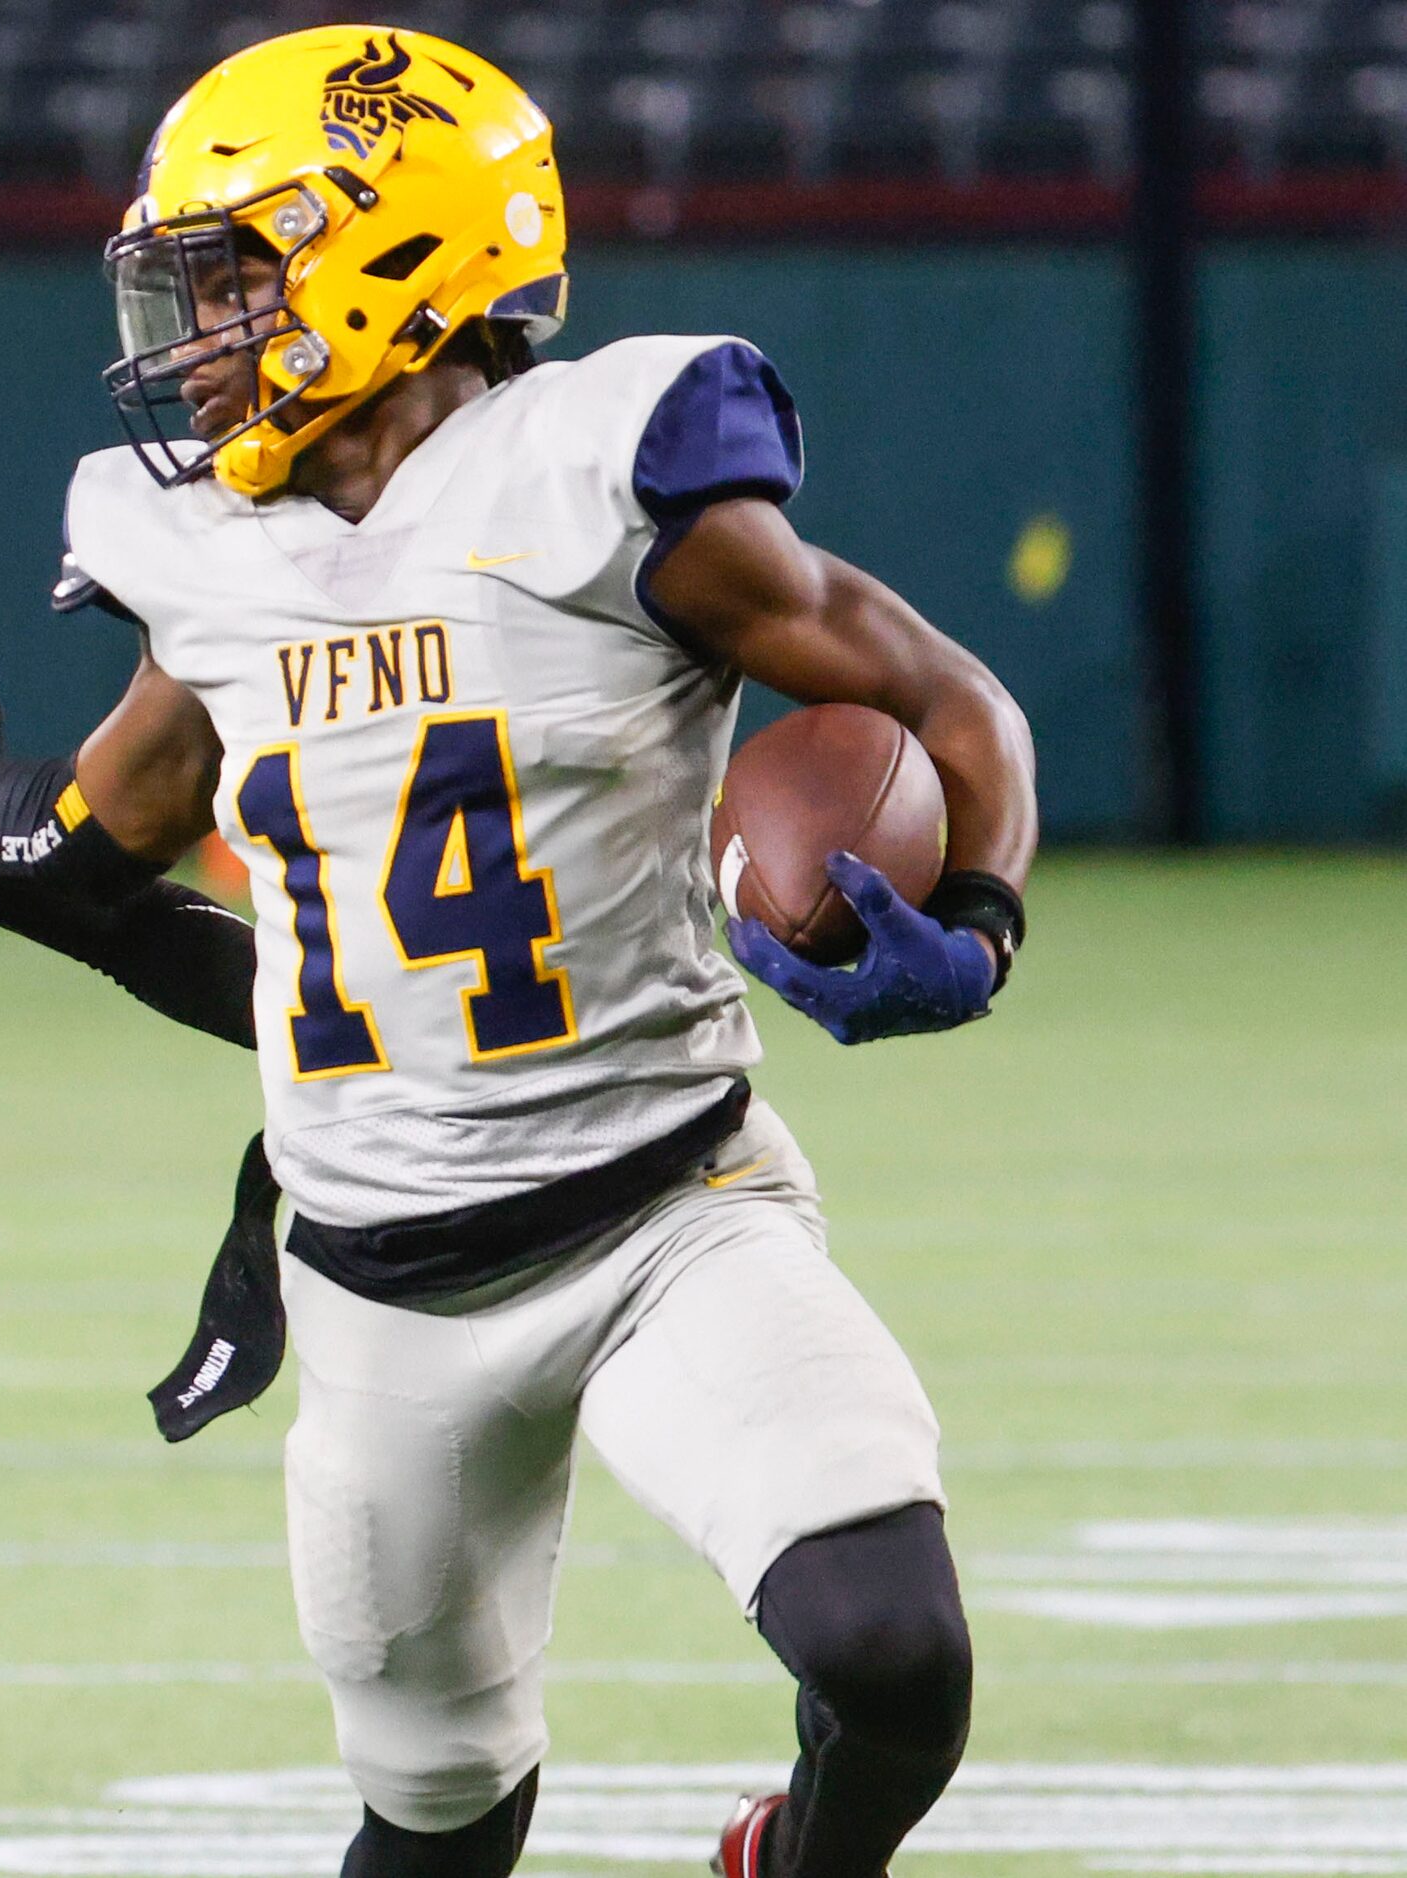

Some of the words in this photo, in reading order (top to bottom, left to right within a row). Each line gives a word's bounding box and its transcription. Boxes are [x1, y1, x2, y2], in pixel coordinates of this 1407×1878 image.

[334, 93, 388, 137] LHS
[277, 618, 453, 728] VFND
[234, 708, 580, 1082] 14
